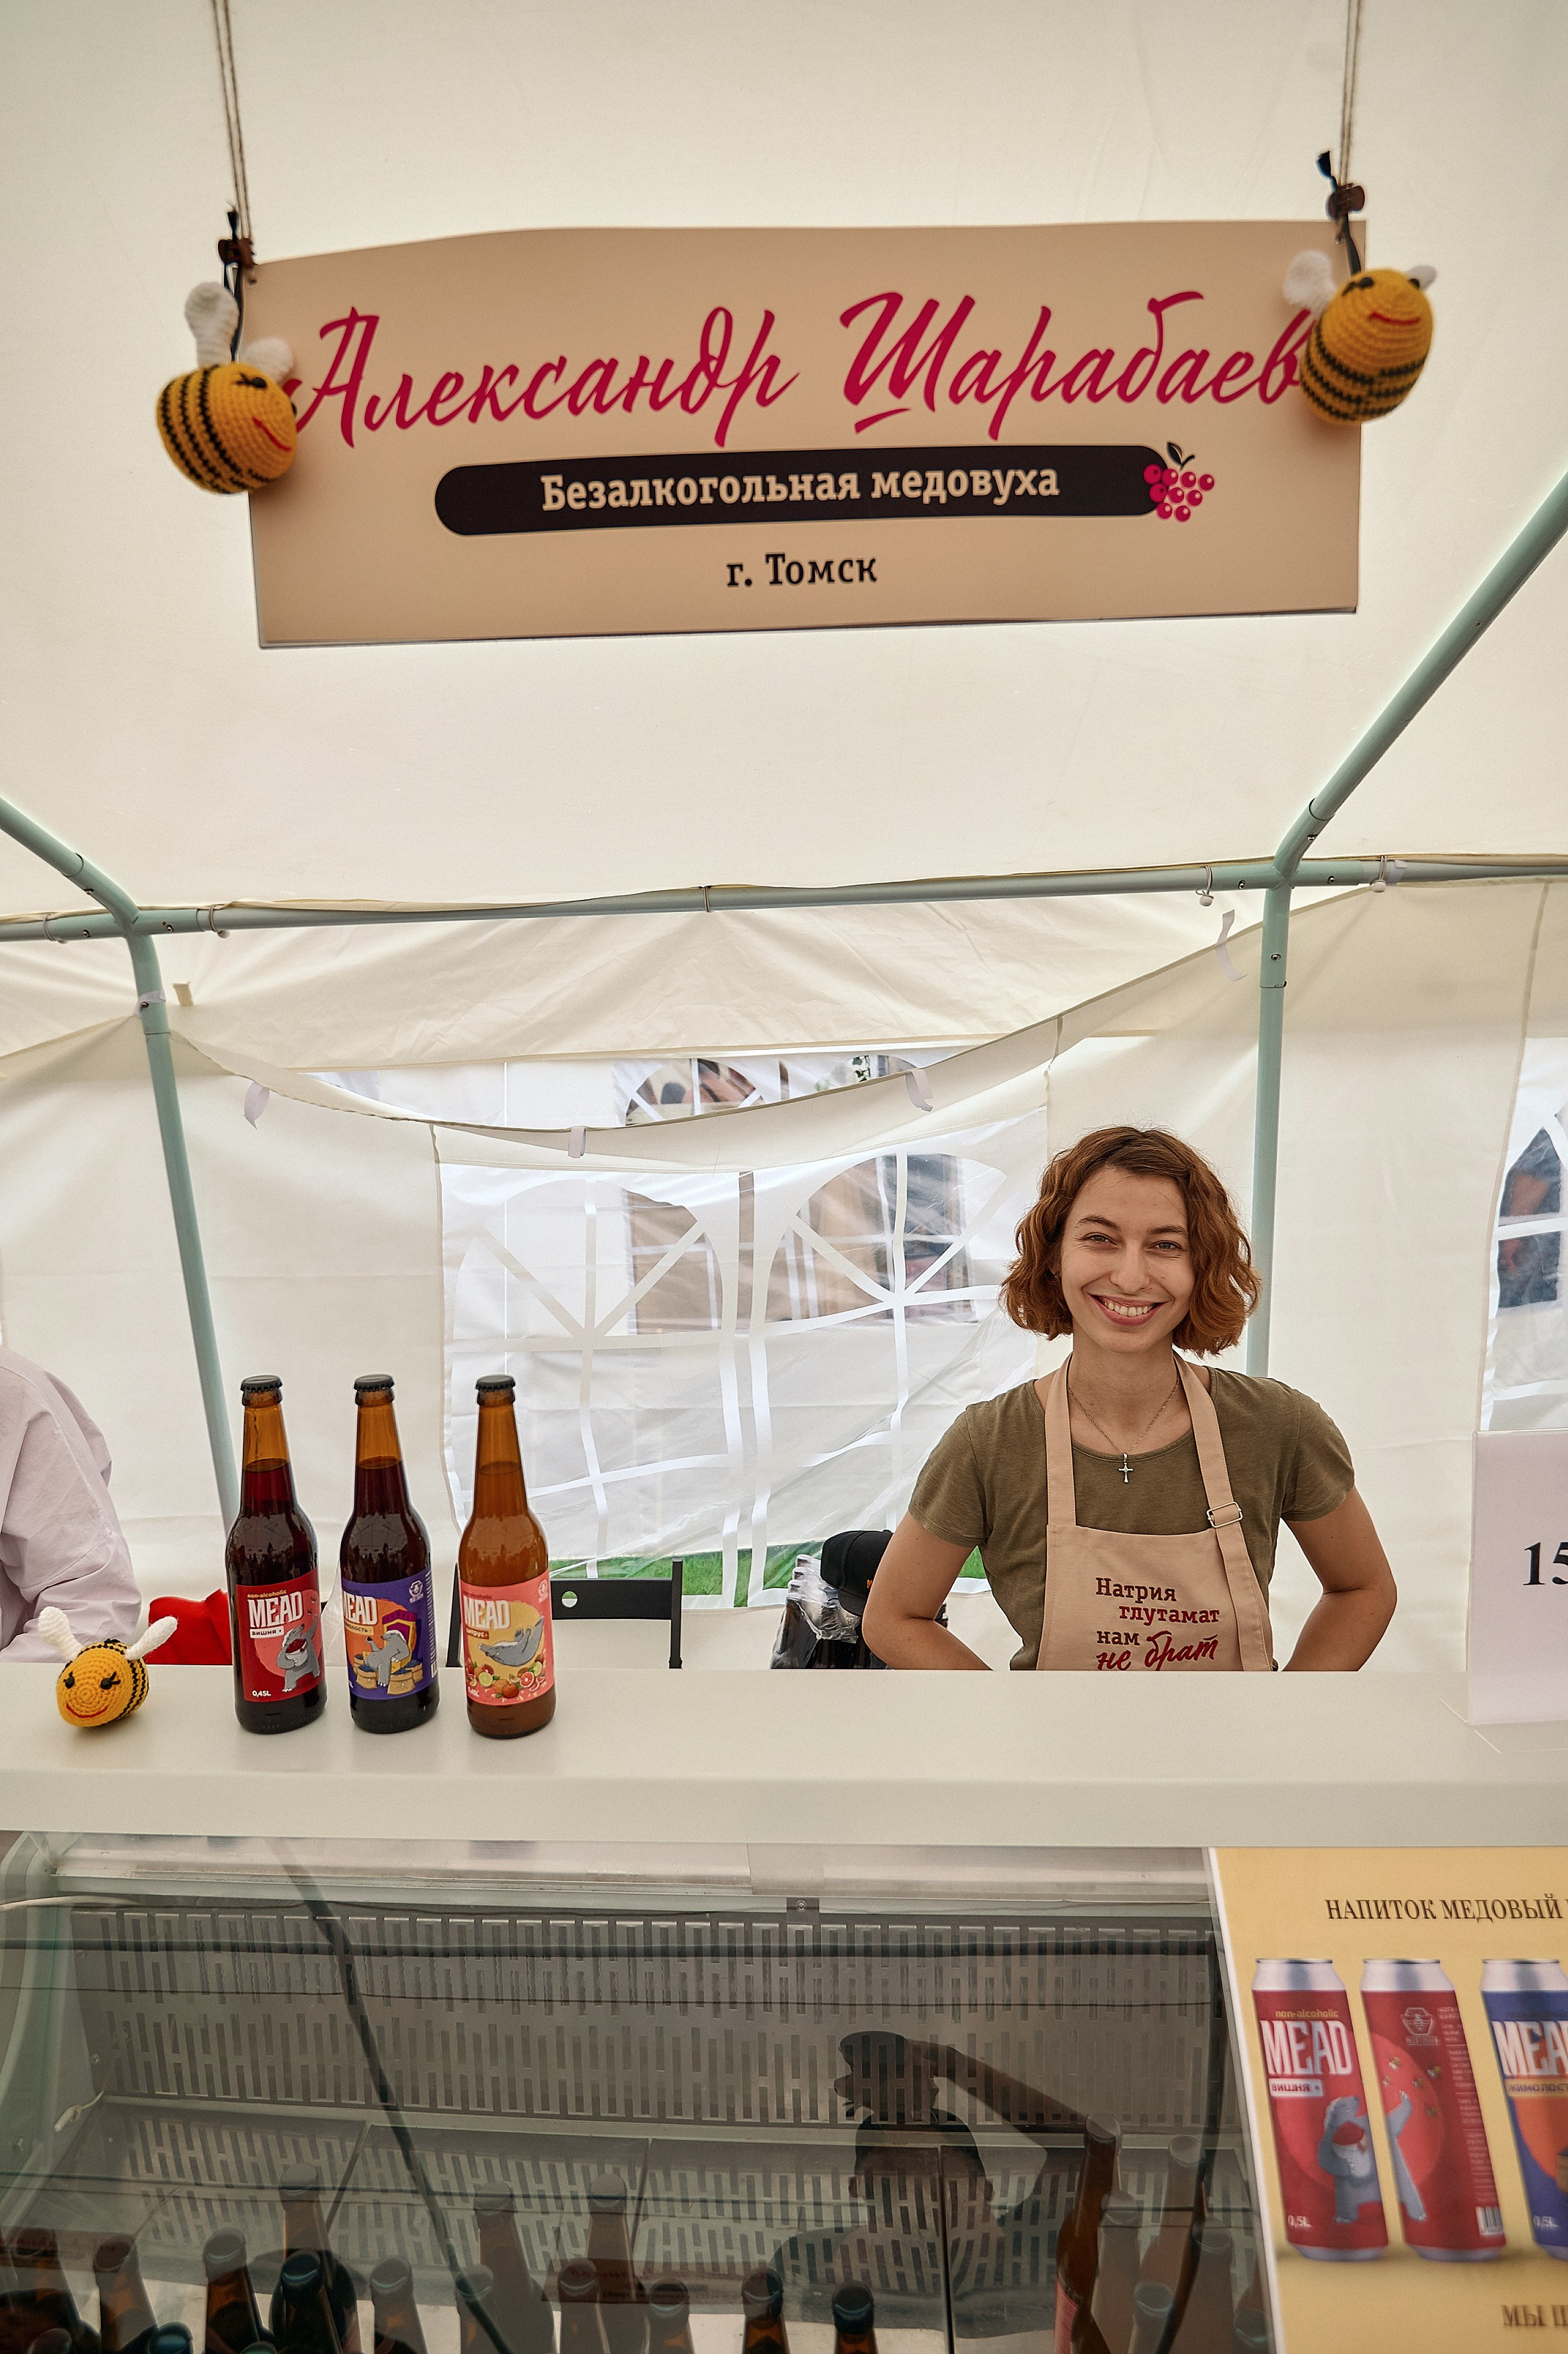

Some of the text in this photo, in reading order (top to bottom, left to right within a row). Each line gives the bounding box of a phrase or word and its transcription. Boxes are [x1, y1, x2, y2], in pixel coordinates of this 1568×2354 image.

[282, 291, 1317, 449] Александр Шарабаев
[540, 467, 1060, 511] Безалкогольная медовуха
[726, 552, 877, 587] г. Томск
[247, 1589, 286, 1599] non-alcoholic
[1095, 1577, 1177, 1604] Натрия
[247, 1591, 303, 1628] MEAD
[463, 1594, 511, 1630] MEAD
[1119, 1605, 1220, 1626] глутамат
[1096, 1630, 1140, 1646] нам
[1096, 1630, 1219, 1671] не брат
[1325, 1893, 1564, 1924] НАПИТОК МЕДОВЫЙ
[1275, 2008, 1339, 2018] non-alcoholic
[1259, 2020, 1353, 2076] MEAD
[1287, 2215, 1311, 2228] 0,5L
[1501, 2304, 1547, 2327] МЫ
